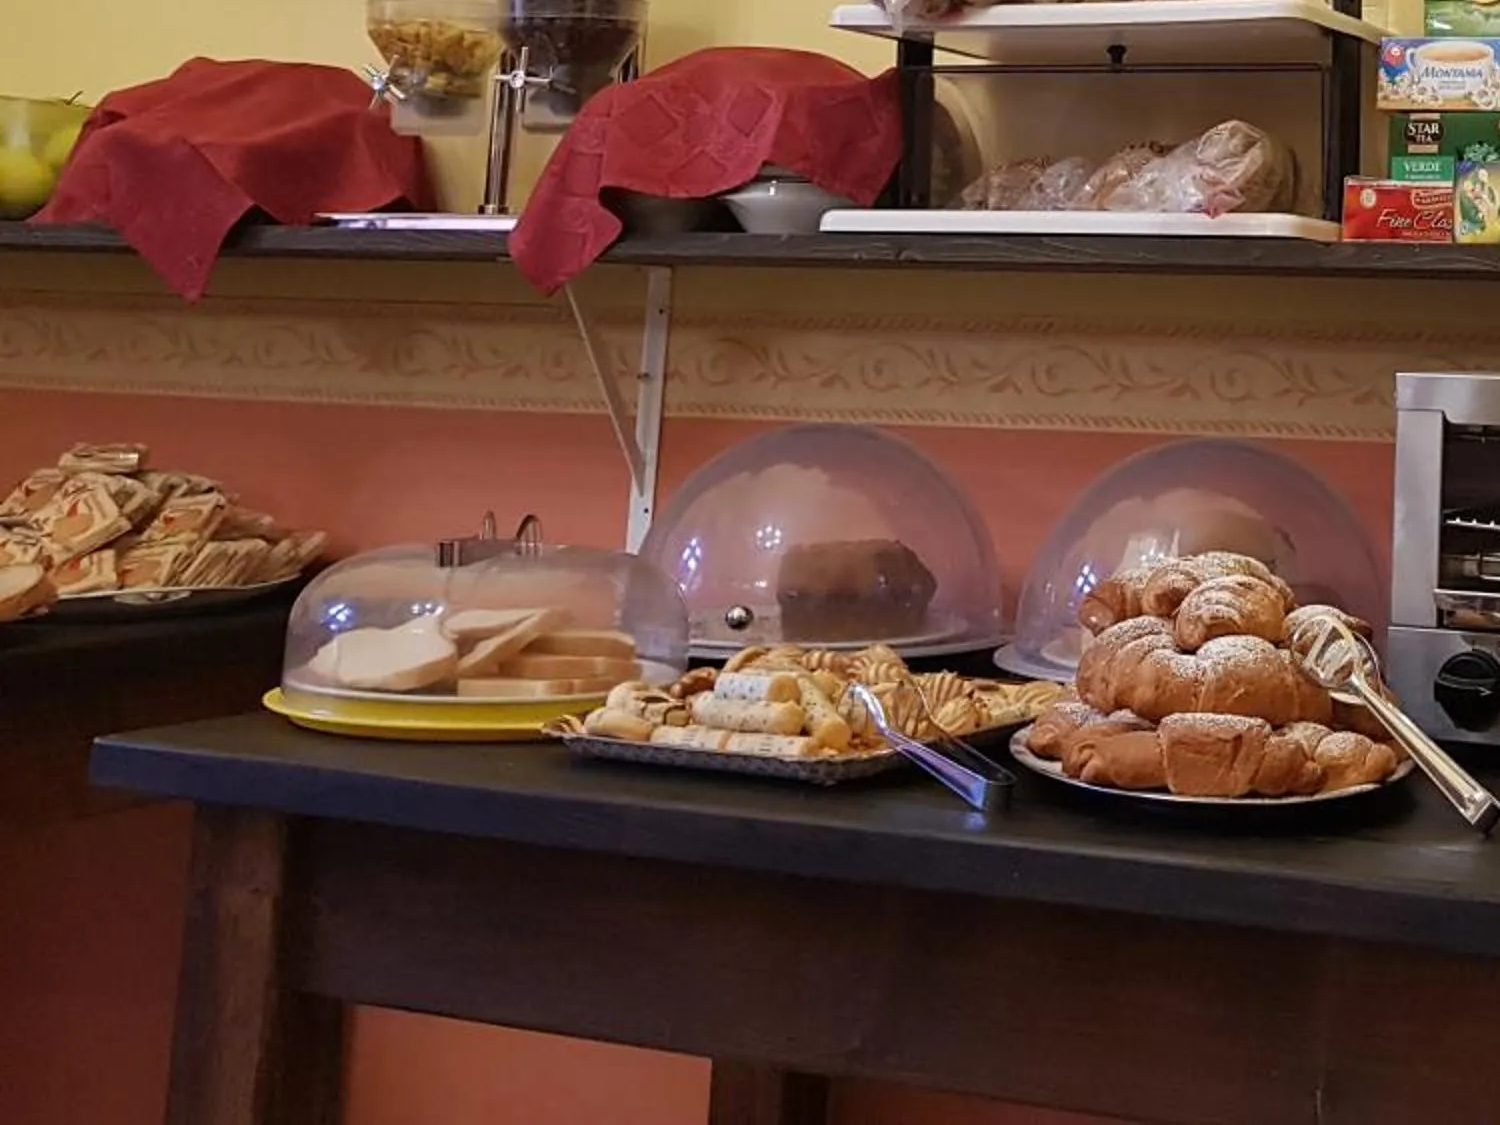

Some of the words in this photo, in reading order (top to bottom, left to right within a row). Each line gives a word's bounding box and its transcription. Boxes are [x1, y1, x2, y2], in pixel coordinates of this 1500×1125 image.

[1407, 122, 1439, 136] STAR
[1413, 135, 1433, 144] TEA
[1403, 161, 1441, 172] VERDE
[1376, 208, 1412, 228] Fine
